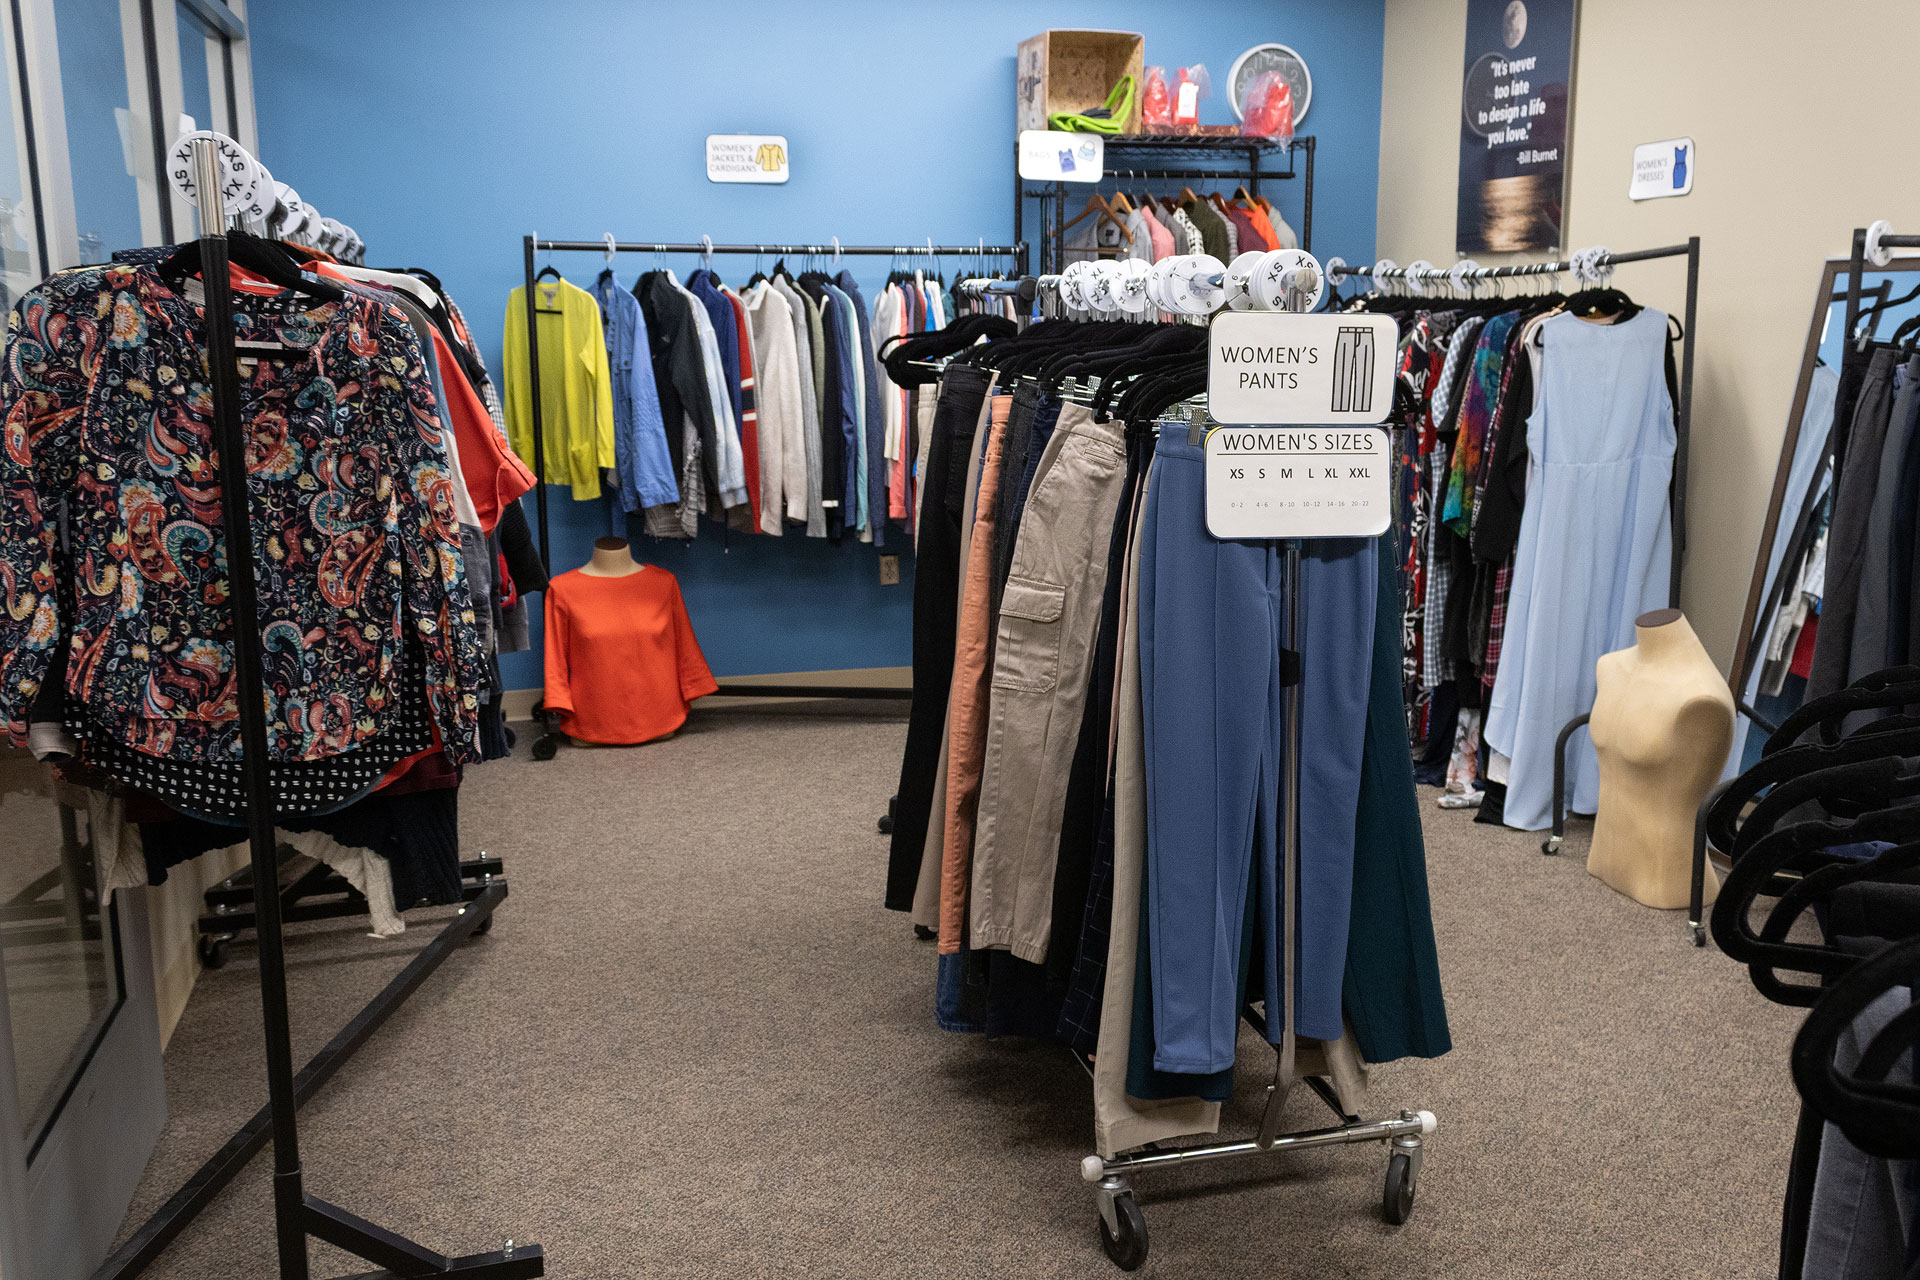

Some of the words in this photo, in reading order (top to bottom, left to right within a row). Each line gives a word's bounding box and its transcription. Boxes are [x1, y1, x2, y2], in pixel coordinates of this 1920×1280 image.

[1509, 56, 1537, 74] never
[1494, 85, 1510, 100] too
[1511, 80, 1530, 97] late
[1478, 110, 1488, 125] to
[1489, 104, 1520, 124] design
[1520, 104, 1527, 117] a
[1528, 98, 1546, 116] life
[711, 143, 753, 152] WOMEN'S
[1487, 131, 1505, 149] you
[219, 140, 245, 172] XXS
[711, 154, 745, 162] JACKETS
[747, 154, 753, 162] &
[1516, 150, 1531, 165] -Bill
[1532, 148, 1558, 163] Burnet
[1636, 158, 1668, 170] WOMEN'S
[709, 164, 757, 172] CARDIGANS
[1638, 171, 1664, 182] DRESSES
[289, 201, 299, 213] M
[1091, 267, 1104, 280] XL
[1267, 262, 1283, 282] XS
[1221, 346, 1318, 364] WOMEN'S
[1239, 372, 1298, 389] PANTS
[1223, 433, 1318, 451] WOMEN'S
[1324, 433, 1373, 450] SIZES
[1230, 468, 1244, 479] XS
[1258, 468, 1265, 479] S
[1281, 468, 1293, 479] M
[1308, 468, 1315, 478] L
[1324, 468, 1338, 478] XL
[1349, 467, 1371, 478] XXL
